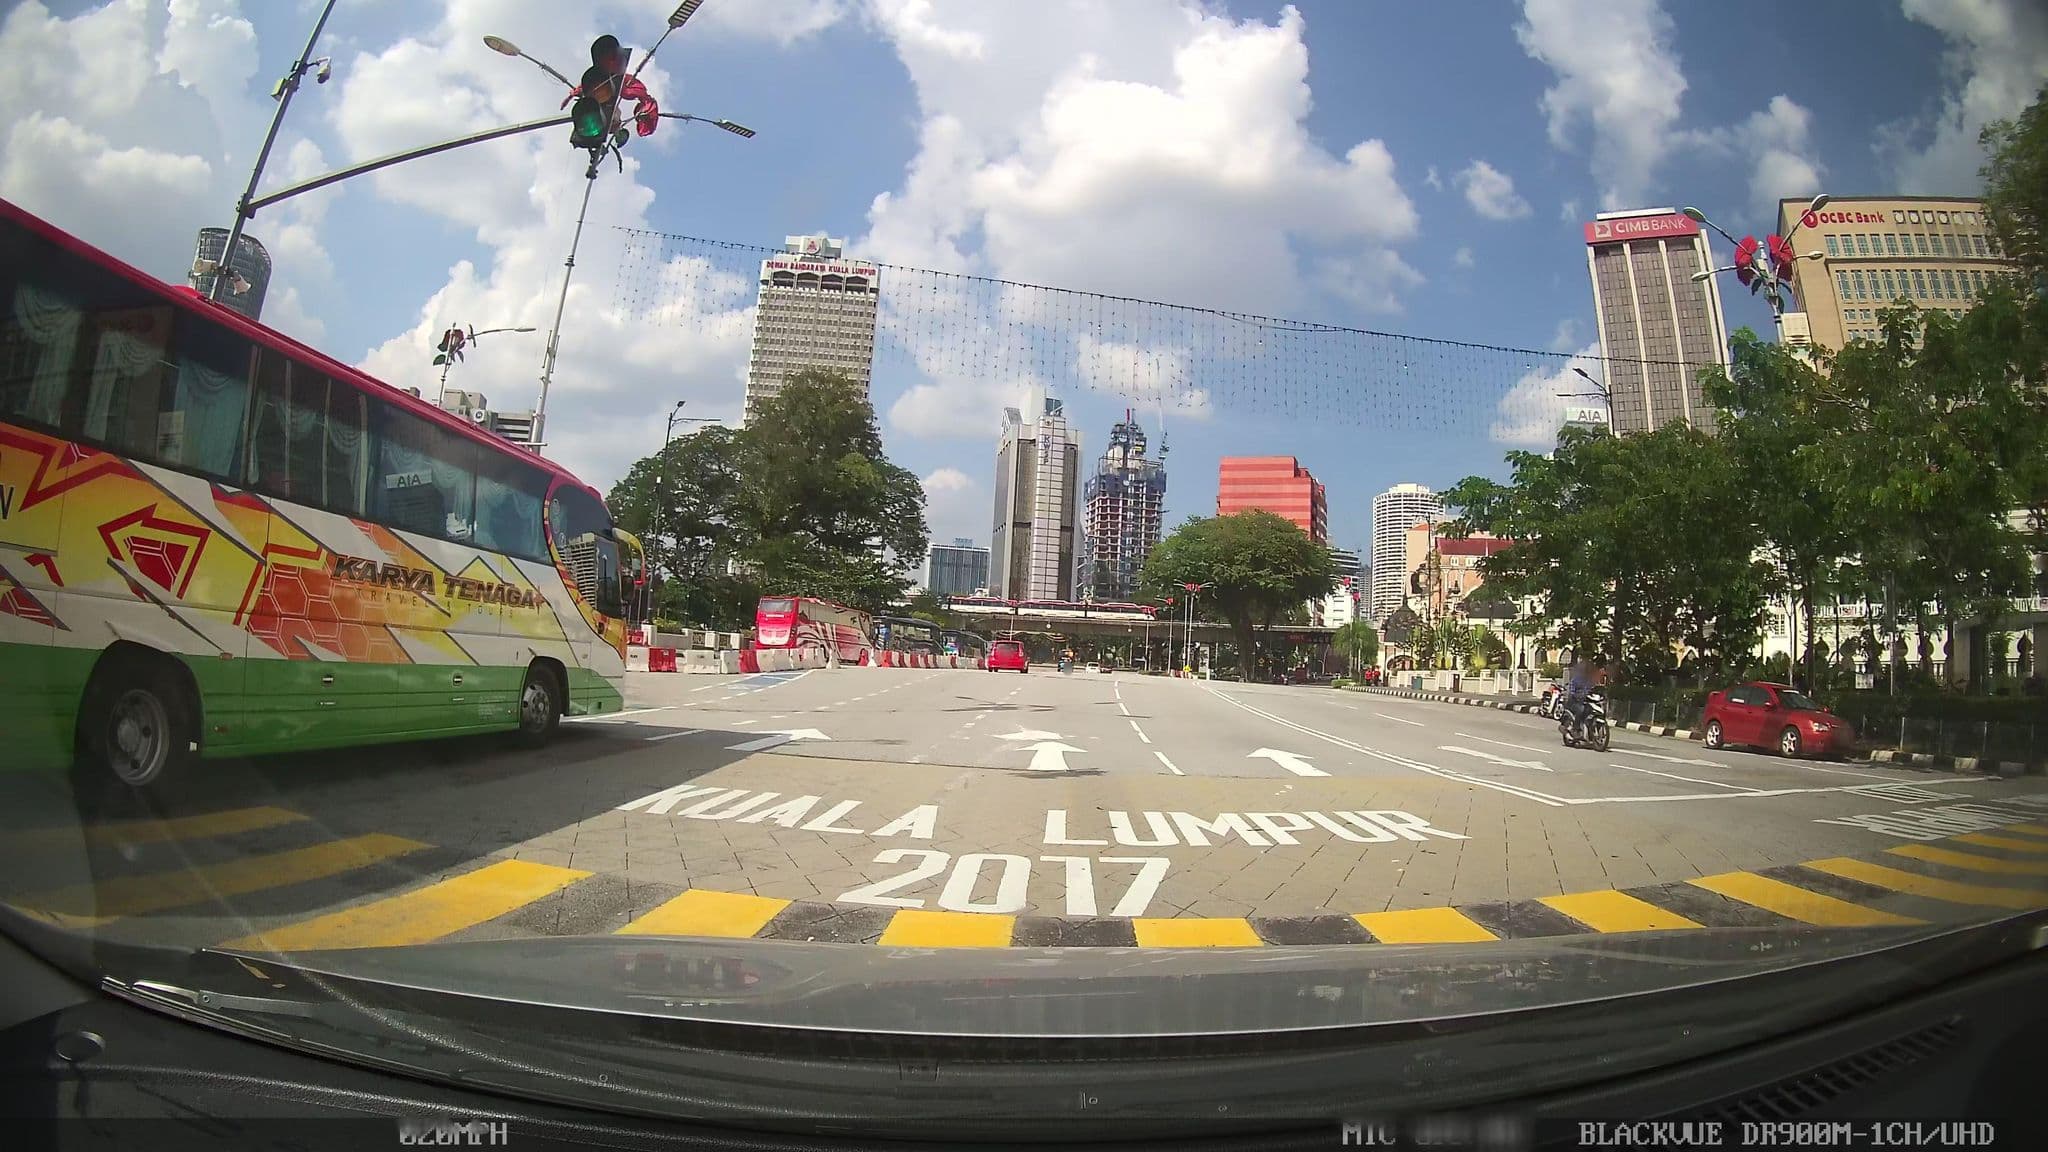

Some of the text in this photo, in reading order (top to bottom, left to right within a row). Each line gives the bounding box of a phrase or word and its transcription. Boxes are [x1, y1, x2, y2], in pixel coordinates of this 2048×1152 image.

[1820, 211, 1885, 224] OCBC Bank
[1615, 218, 1687, 233] CIMB BANK
[767, 261, 788, 270] DEWAN
[828, 265, 849, 274] KUALA
[852, 267, 877, 276] LUMPUR
[1577, 409, 1602, 422] AIA
[332, 556, 537, 609] KARYA TENAGA
[615, 784, 1473, 847] KUALA LUMPUR
[836, 848, 1172, 917] 2017
